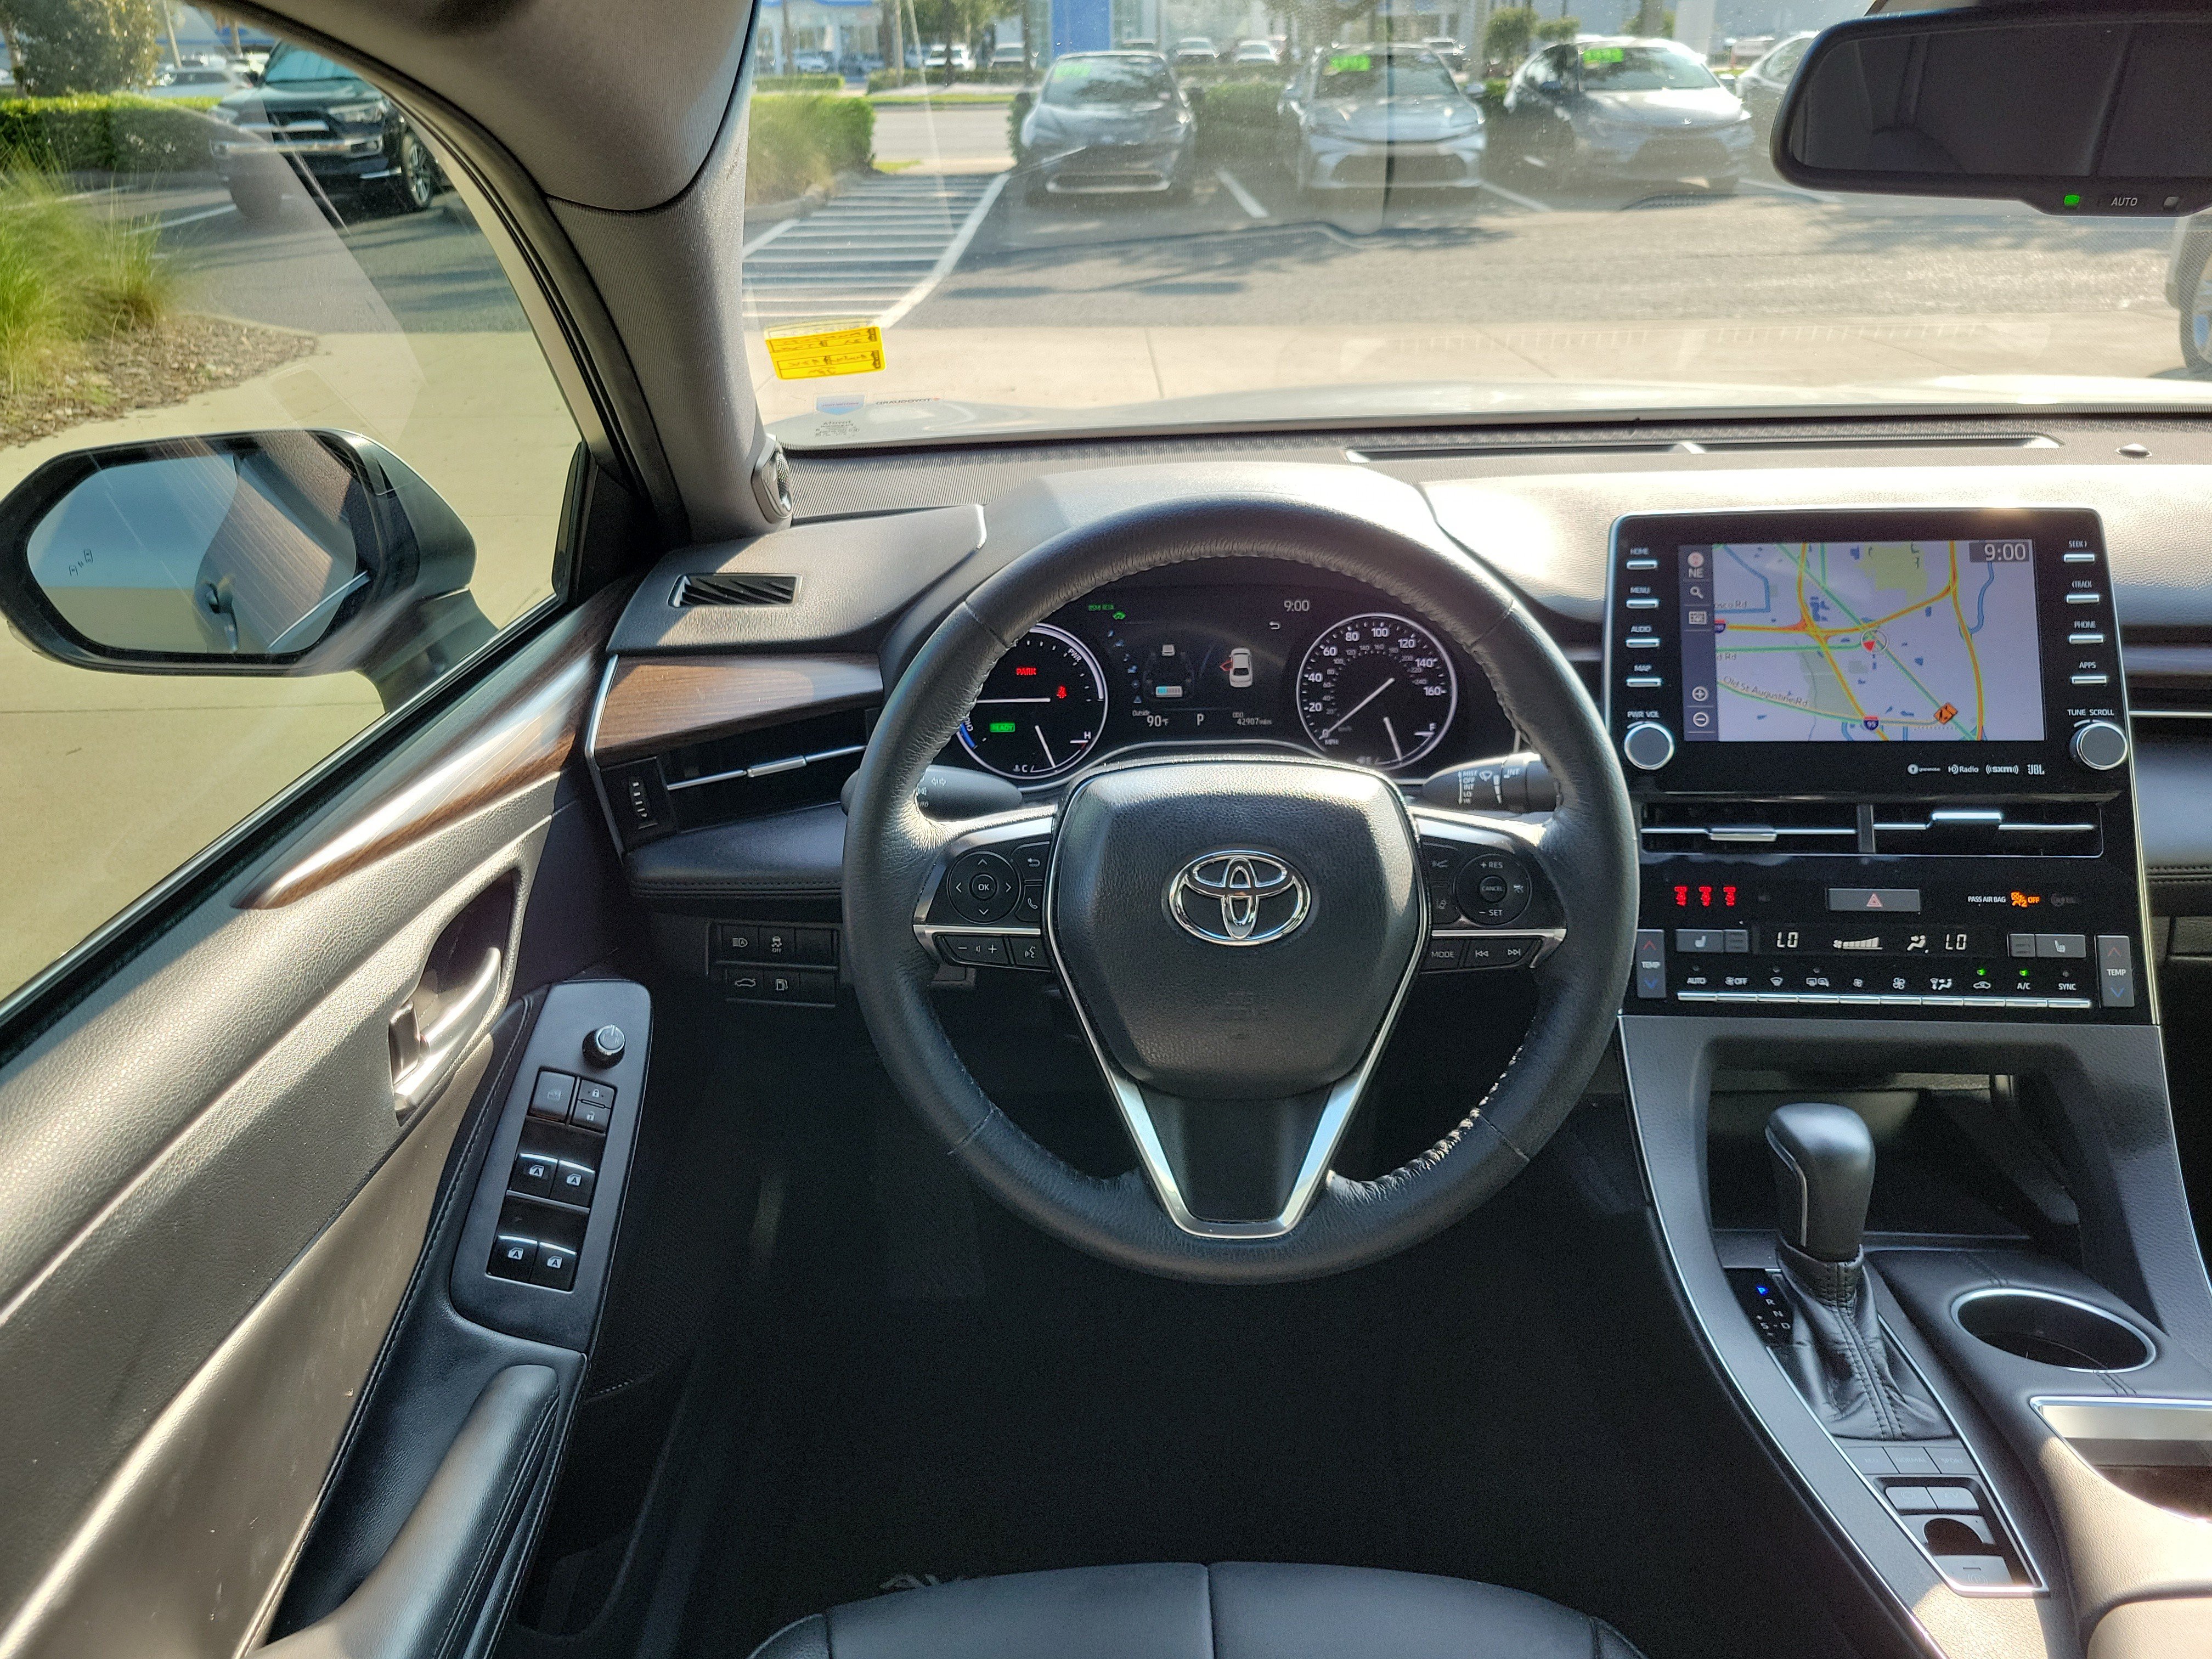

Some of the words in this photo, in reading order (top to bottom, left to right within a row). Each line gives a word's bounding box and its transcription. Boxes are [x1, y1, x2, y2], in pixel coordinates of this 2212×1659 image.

[2111, 198, 2137, 206] AUTO
[1984, 544, 2026, 561] 9:00
[1689, 568, 1703, 578] NE
[1284, 600, 1309, 612] 9:00
[1345, 632, 1360, 641] 80
[1372, 628, 1390, 637] 100
[1398, 639, 1416, 648] 120
[1068, 648, 1082, 662] PWR
[1323, 647, 1338, 656] 60
[1415, 659, 1434, 667] 140
[1308, 673, 1323, 682] 40
[1424, 687, 1442, 696] 160
[1309, 703, 1323, 712] 20
[1197, 714, 1204, 725] P
[1022, 765, 1028, 773] C
[2028, 764, 2045, 775] JBL
[1777, 932, 1798, 948] LO
[1945, 934, 1967, 950] LO
